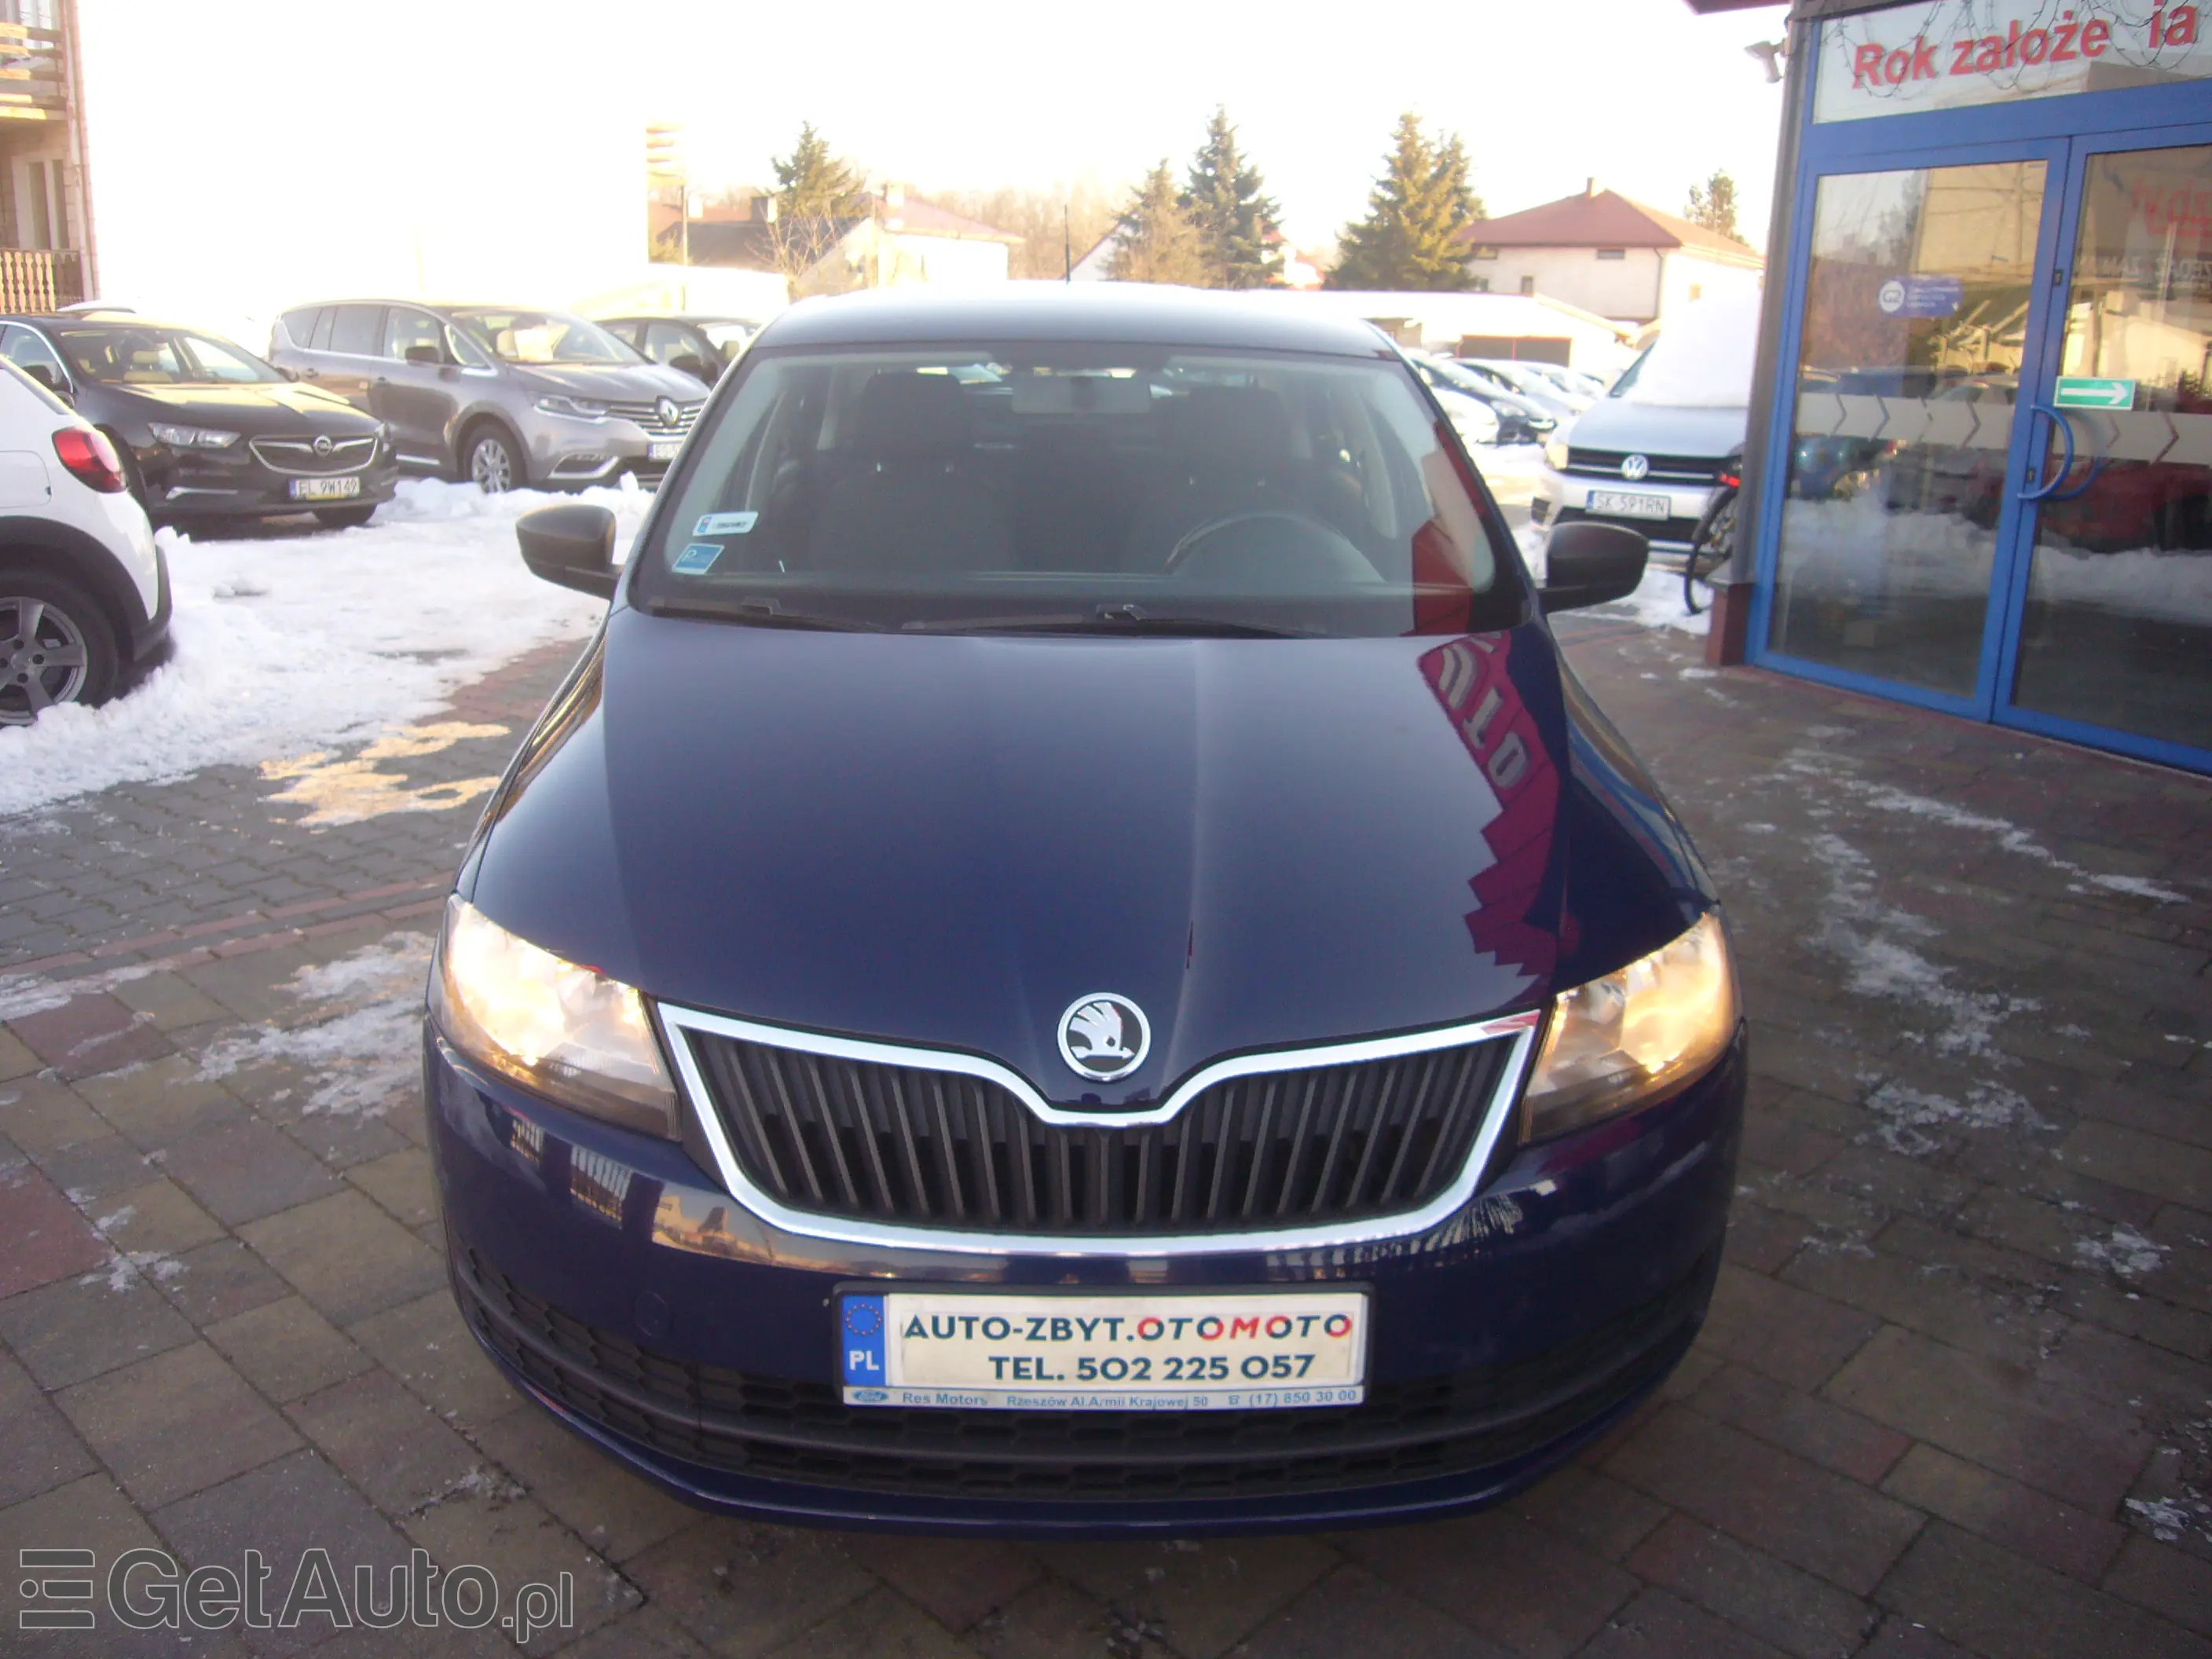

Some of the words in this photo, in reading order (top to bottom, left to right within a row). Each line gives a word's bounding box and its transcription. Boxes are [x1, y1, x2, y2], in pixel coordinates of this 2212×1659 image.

[1853, 35, 1939, 90] Rok
[848, 1350, 880, 1371] PL
[988, 1355, 1065, 1381] TEL.
[1075, 1356, 1152, 1382] 502
[1162, 1356, 1229, 1381] 225
[1240, 1353, 1317, 1379] 057
[903, 1392, 931, 1404] Res
[936, 1393, 988, 1406] Motors
[1005, 1394, 1068, 1407] Rzeszów
[1129, 1395, 1189, 1411] Krajowej
[1192, 1395, 1209, 1407] 50
[1249, 1393, 1278, 1408] (17)
[1283, 1391, 1311, 1404] 850
[1316, 1390, 1334, 1402] 30
[1338, 1389, 1357, 1401] 00
